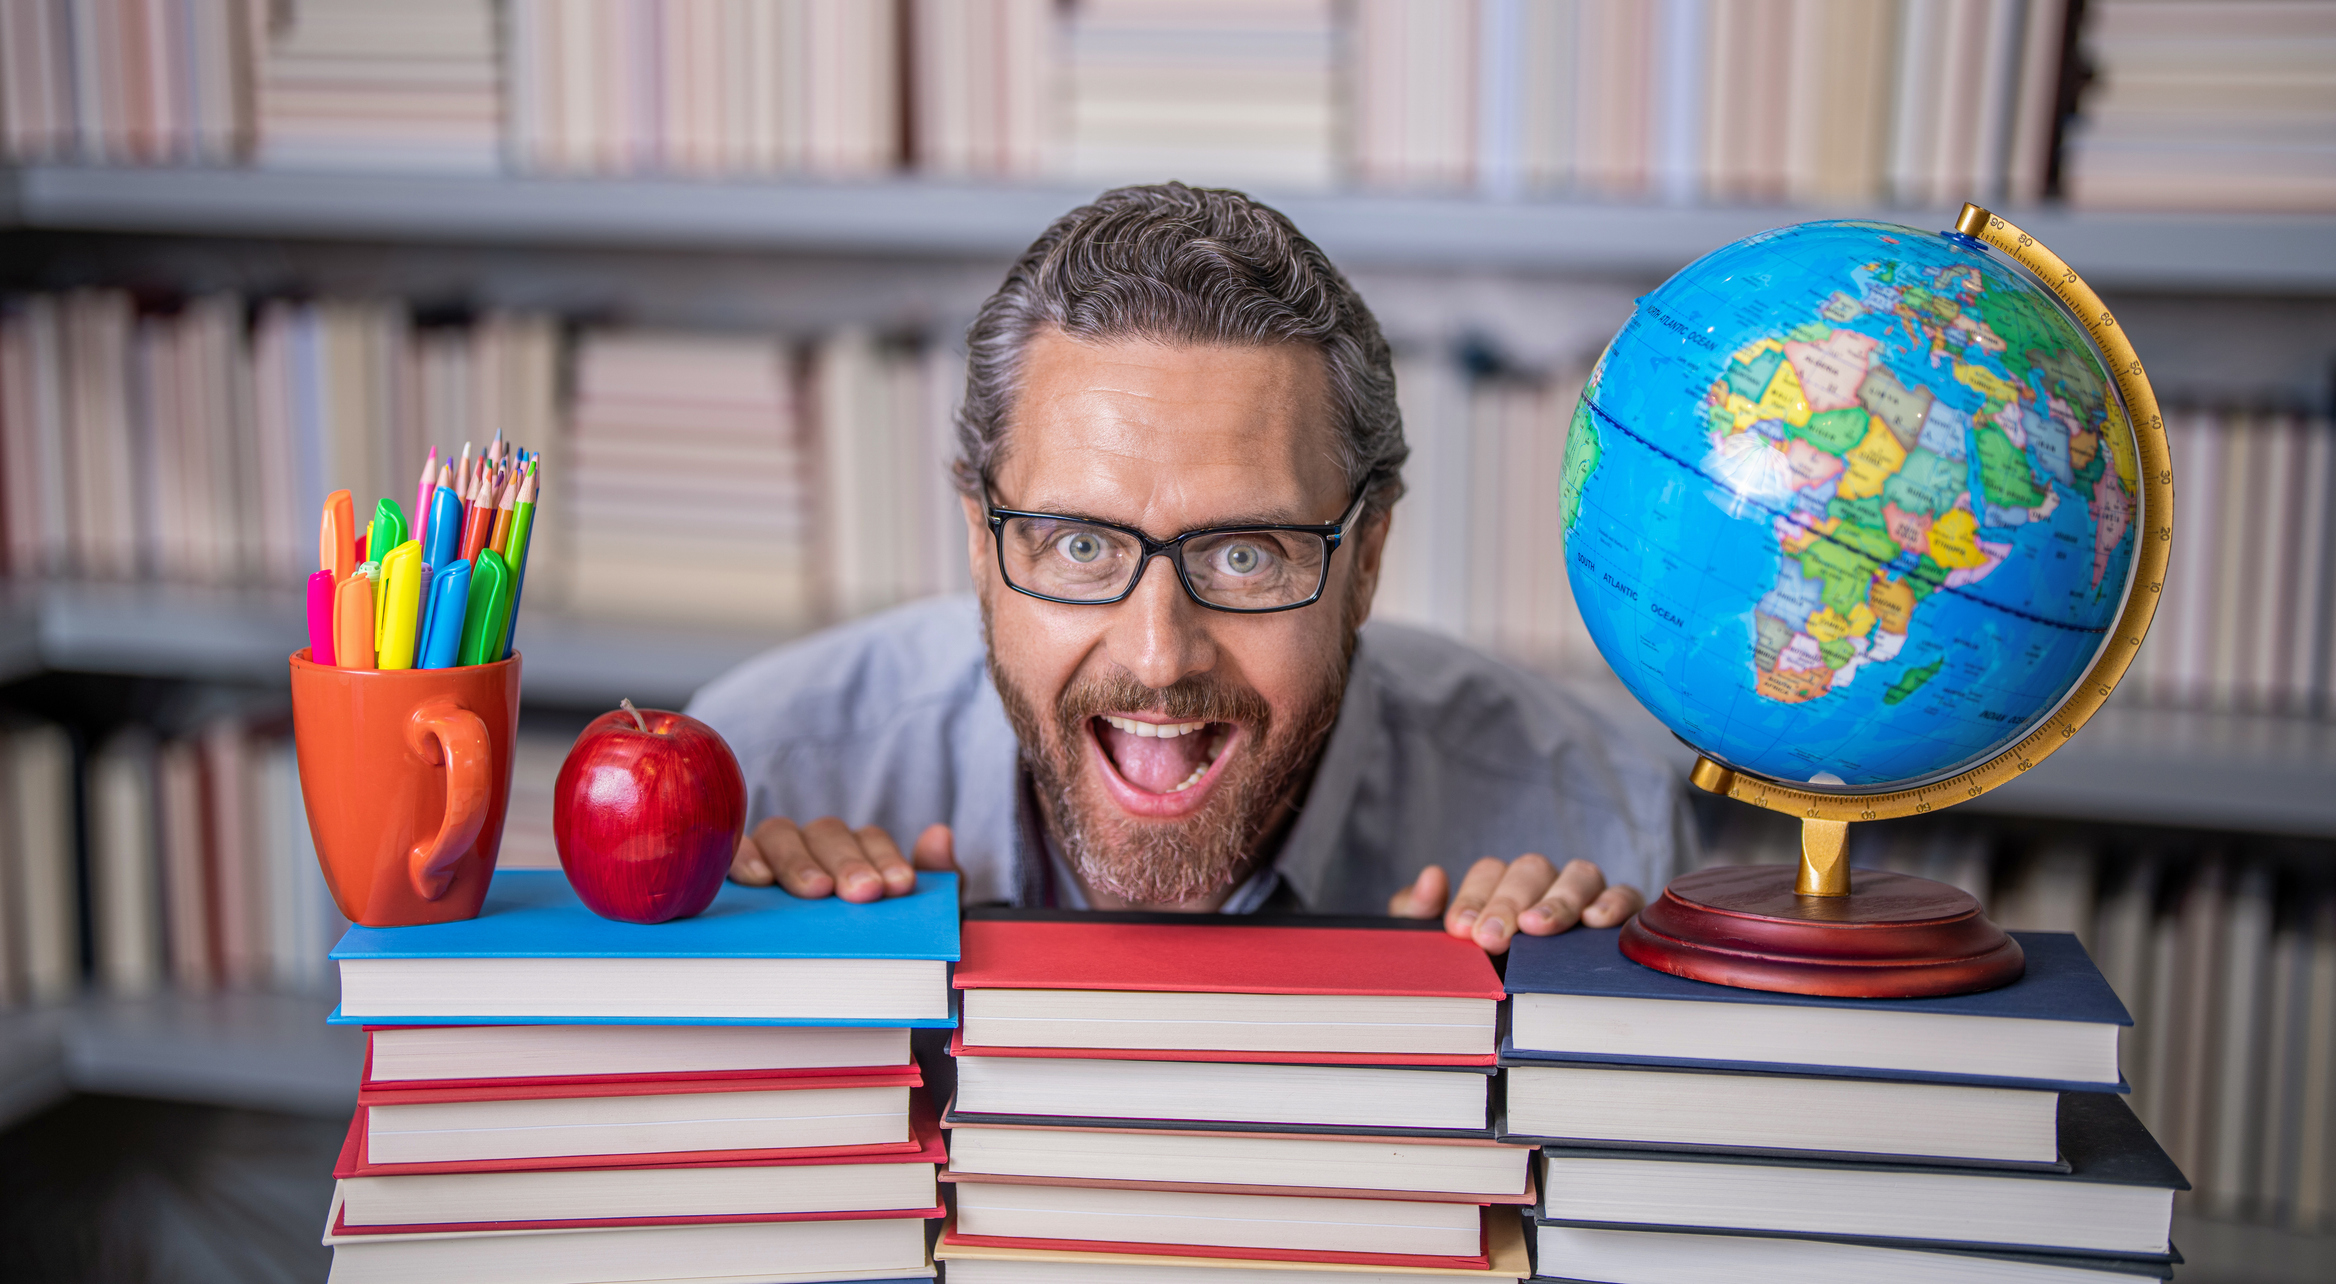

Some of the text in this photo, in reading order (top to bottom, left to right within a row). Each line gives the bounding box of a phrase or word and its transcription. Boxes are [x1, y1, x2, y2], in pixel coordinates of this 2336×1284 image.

[2018, 233, 2033, 247] 80
[2062, 268, 2077, 284] 70
[1646, 304, 1661, 319] NORTH
[1659, 314, 1689, 335] ATLANTIC
[1687, 331, 1719, 351] OCEAN
[2130, 360, 2142, 376] 50
[2150, 414, 2161, 430] 40
[2160, 470, 2171, 485] 30
[2160, 526, 2170, 541] 20
[1577, 552, 1685, 628] SOUTH ATLANTIC OCEAN
[2150, 582, 2161, 593] 10
[2130, 637, 2139, 646] 0
[2098, 683, 2112, 696] 10
[1979, 710, 2008, 722] INDIAN
[2061, 723, 2076, 739] 20
[2017, 758, 2033, 772] 30
[1806, 808, 1820, 818] 70
